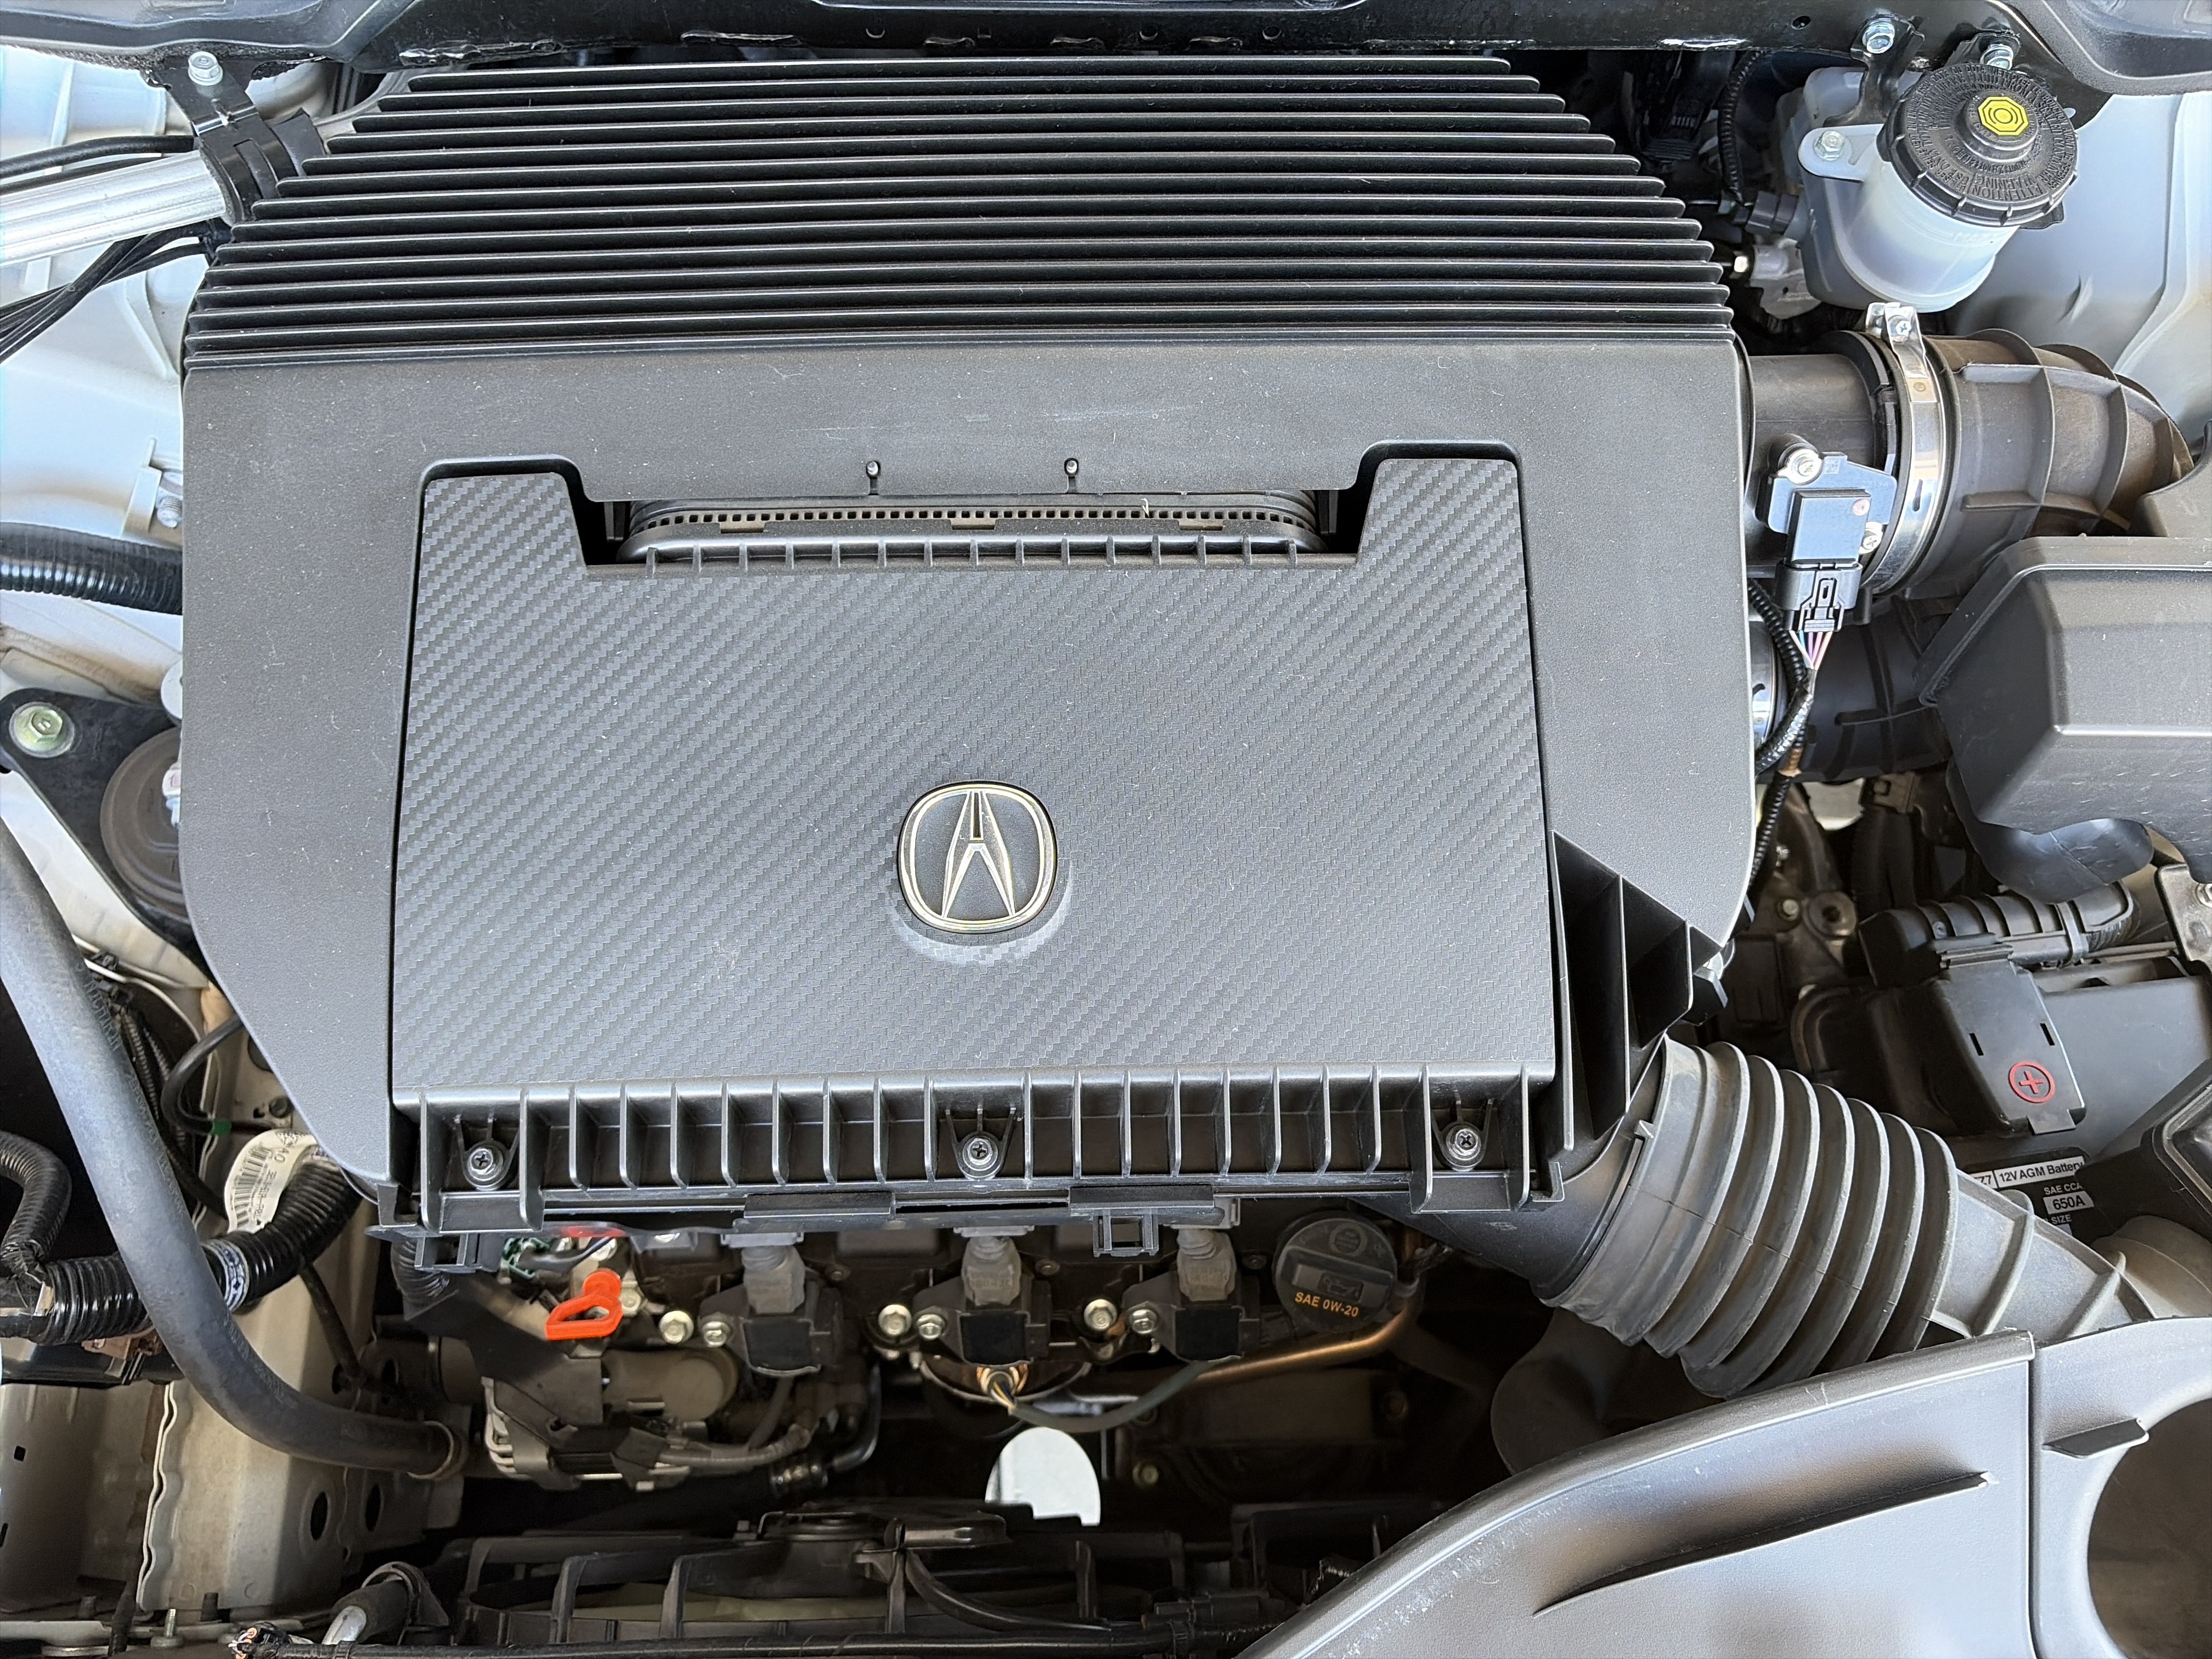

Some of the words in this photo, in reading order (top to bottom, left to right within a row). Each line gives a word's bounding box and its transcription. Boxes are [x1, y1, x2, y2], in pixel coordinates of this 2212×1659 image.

[1993, 69, 2032, 88] NETTOYER
[2041, 94, 2069, 126] BOUCHON
[2063, 127, 2075, 151] AVANT
[1950, 168, 1970, 185] USE
[1975, 171, 2038, 191] WARNING
[1972, 182, 2042, 201] ATTENTION
[1999, 1171, 2017, 1182] 12V
[2019, 1167, 2046, 1180] AGM
[2044, 1184, 2063, 1195] SAE
[2052, 1195, 2086, 1210] 650A
[2051, 1214, 2073, 1225] SIZE
[1294, 1291, 1321, 1307] SAE
[1322, 1299, 1359, 1318] 0W-20
